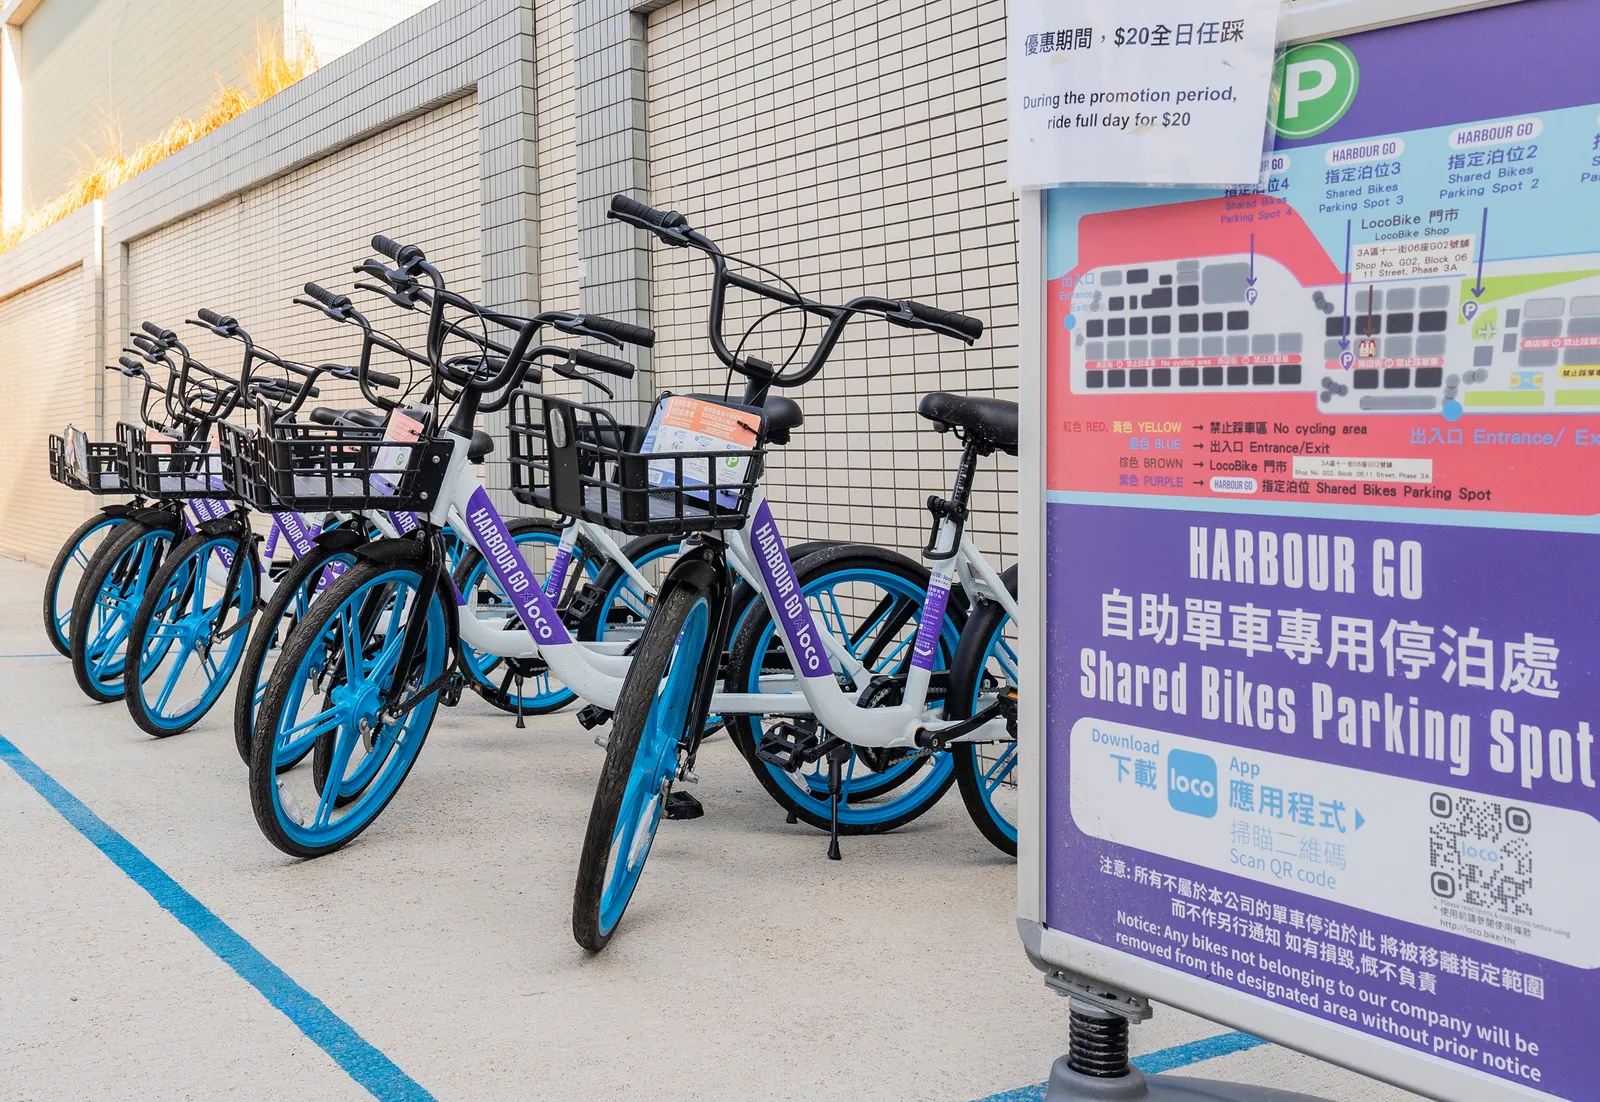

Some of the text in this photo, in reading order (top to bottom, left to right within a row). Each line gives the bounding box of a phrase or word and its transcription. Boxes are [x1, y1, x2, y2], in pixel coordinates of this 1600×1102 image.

[1023, 86, 1237, 109] During the promotion period,
[1284, 59, 1336, 119] P
[1048, 111, 1191, 130] ride full day for $20
[1457, 122, 1533, 145] HARBOUR GO
[1332, 142, 1396, 162] HARBOUR GO
[1448, 145, 1538, 170] 指定泊位2
[1272, 158, 1284, 170] GO
[1325, 161, 1401, 185] 指定泊位3
[1448, 166, 1533, 184] Shared Bikes
[1325, 183, 1398, 199] Shared Bikes
[1439, 178, 1539, 199] Parking Spot 2
[1221, 207, 1292, 224] Parking Spot 4
[1226, 197, 1287, 211] Shared Bikes
[1319, 195, 1404, 213] Parking Spot 3
[1361, 208, 1459, 230] LocoBike 門市
[1375, 227, 1450, 241] LocoBike Shop
[1355, 261, 1376, 270] Shop
[1381, 260, 1394, 268] No.
[1425, 255, 1448, 264] Block
[1455, 253, 1467, 261] 06
[1363, 263, 1458, 278] 11 Street, Phase 3A
[1063, 421, 1082, 433] 紅色
[1086, 421, 1109, 433] RED,
[1138, 421, 1182, 433] YELLOW
[1273, 423, 1289, 434] No
[1295, 422, 1336, 436] cycling
[1342, 425, 1368, 435] area
[1410, 427, 1463, 445] 出入口
[1474, 427, 1566, 447] Entrance/
[1155, 438, 1181, 450] BLUE
[1210, 440, 1243, 453] 出入口
[1250, 441, 1330, 455] Entrance/Exit
[1119, 456, 1287, 474] 棕色 BROWN LocoBike 門市
[1119, 474, 1491, 502] 紫色 PURPLE HARBOUR GO 指定泊位 Shared Bikes Parking Spot
[296, 540, 311, 555] GO
[470, 507, 553, 639] HARBOUR GO loco
[1189, 526, 1423, 600] HARBOUR GO
[755, 522, 820, 670] HARBOUR GO loco
[1100, 587, 1562, 699] 自助單車專用停泊處
[1080, 647, 1596, 790] Shared Bikes Parking Spot
[1092, 728, 1160, 756] Download
[1110, 753, 1157, 791] 下載
[1230, 756, 1261, 779] App
[1171, 767, 1214, 799] loco
[1229, 778, 1347, 834] 應用程式
[1462, 841, 1498, 862] loco
[1230, 849, 1336, 890] Scan QR code
[1171, 897, 1281, 947] 而不作另行通知
[1440, 899, 1460, 908] Please
[1461, 904, 1474, 912] read
[1475, 907, 1493, 917] terms
[1500, 914, 1531, 927] conditions
[1532, 921, 1552, 932] before
[1554, 928, 1571, 939] using
[1440, 919, 1516, 945] http://loco.bike/tnc
[1117, 909, 1539, 1056] Notice: Any bikes not belonging to our company will be
[1116, 931, 1541, 1083] removed from the designated area without prior notice
